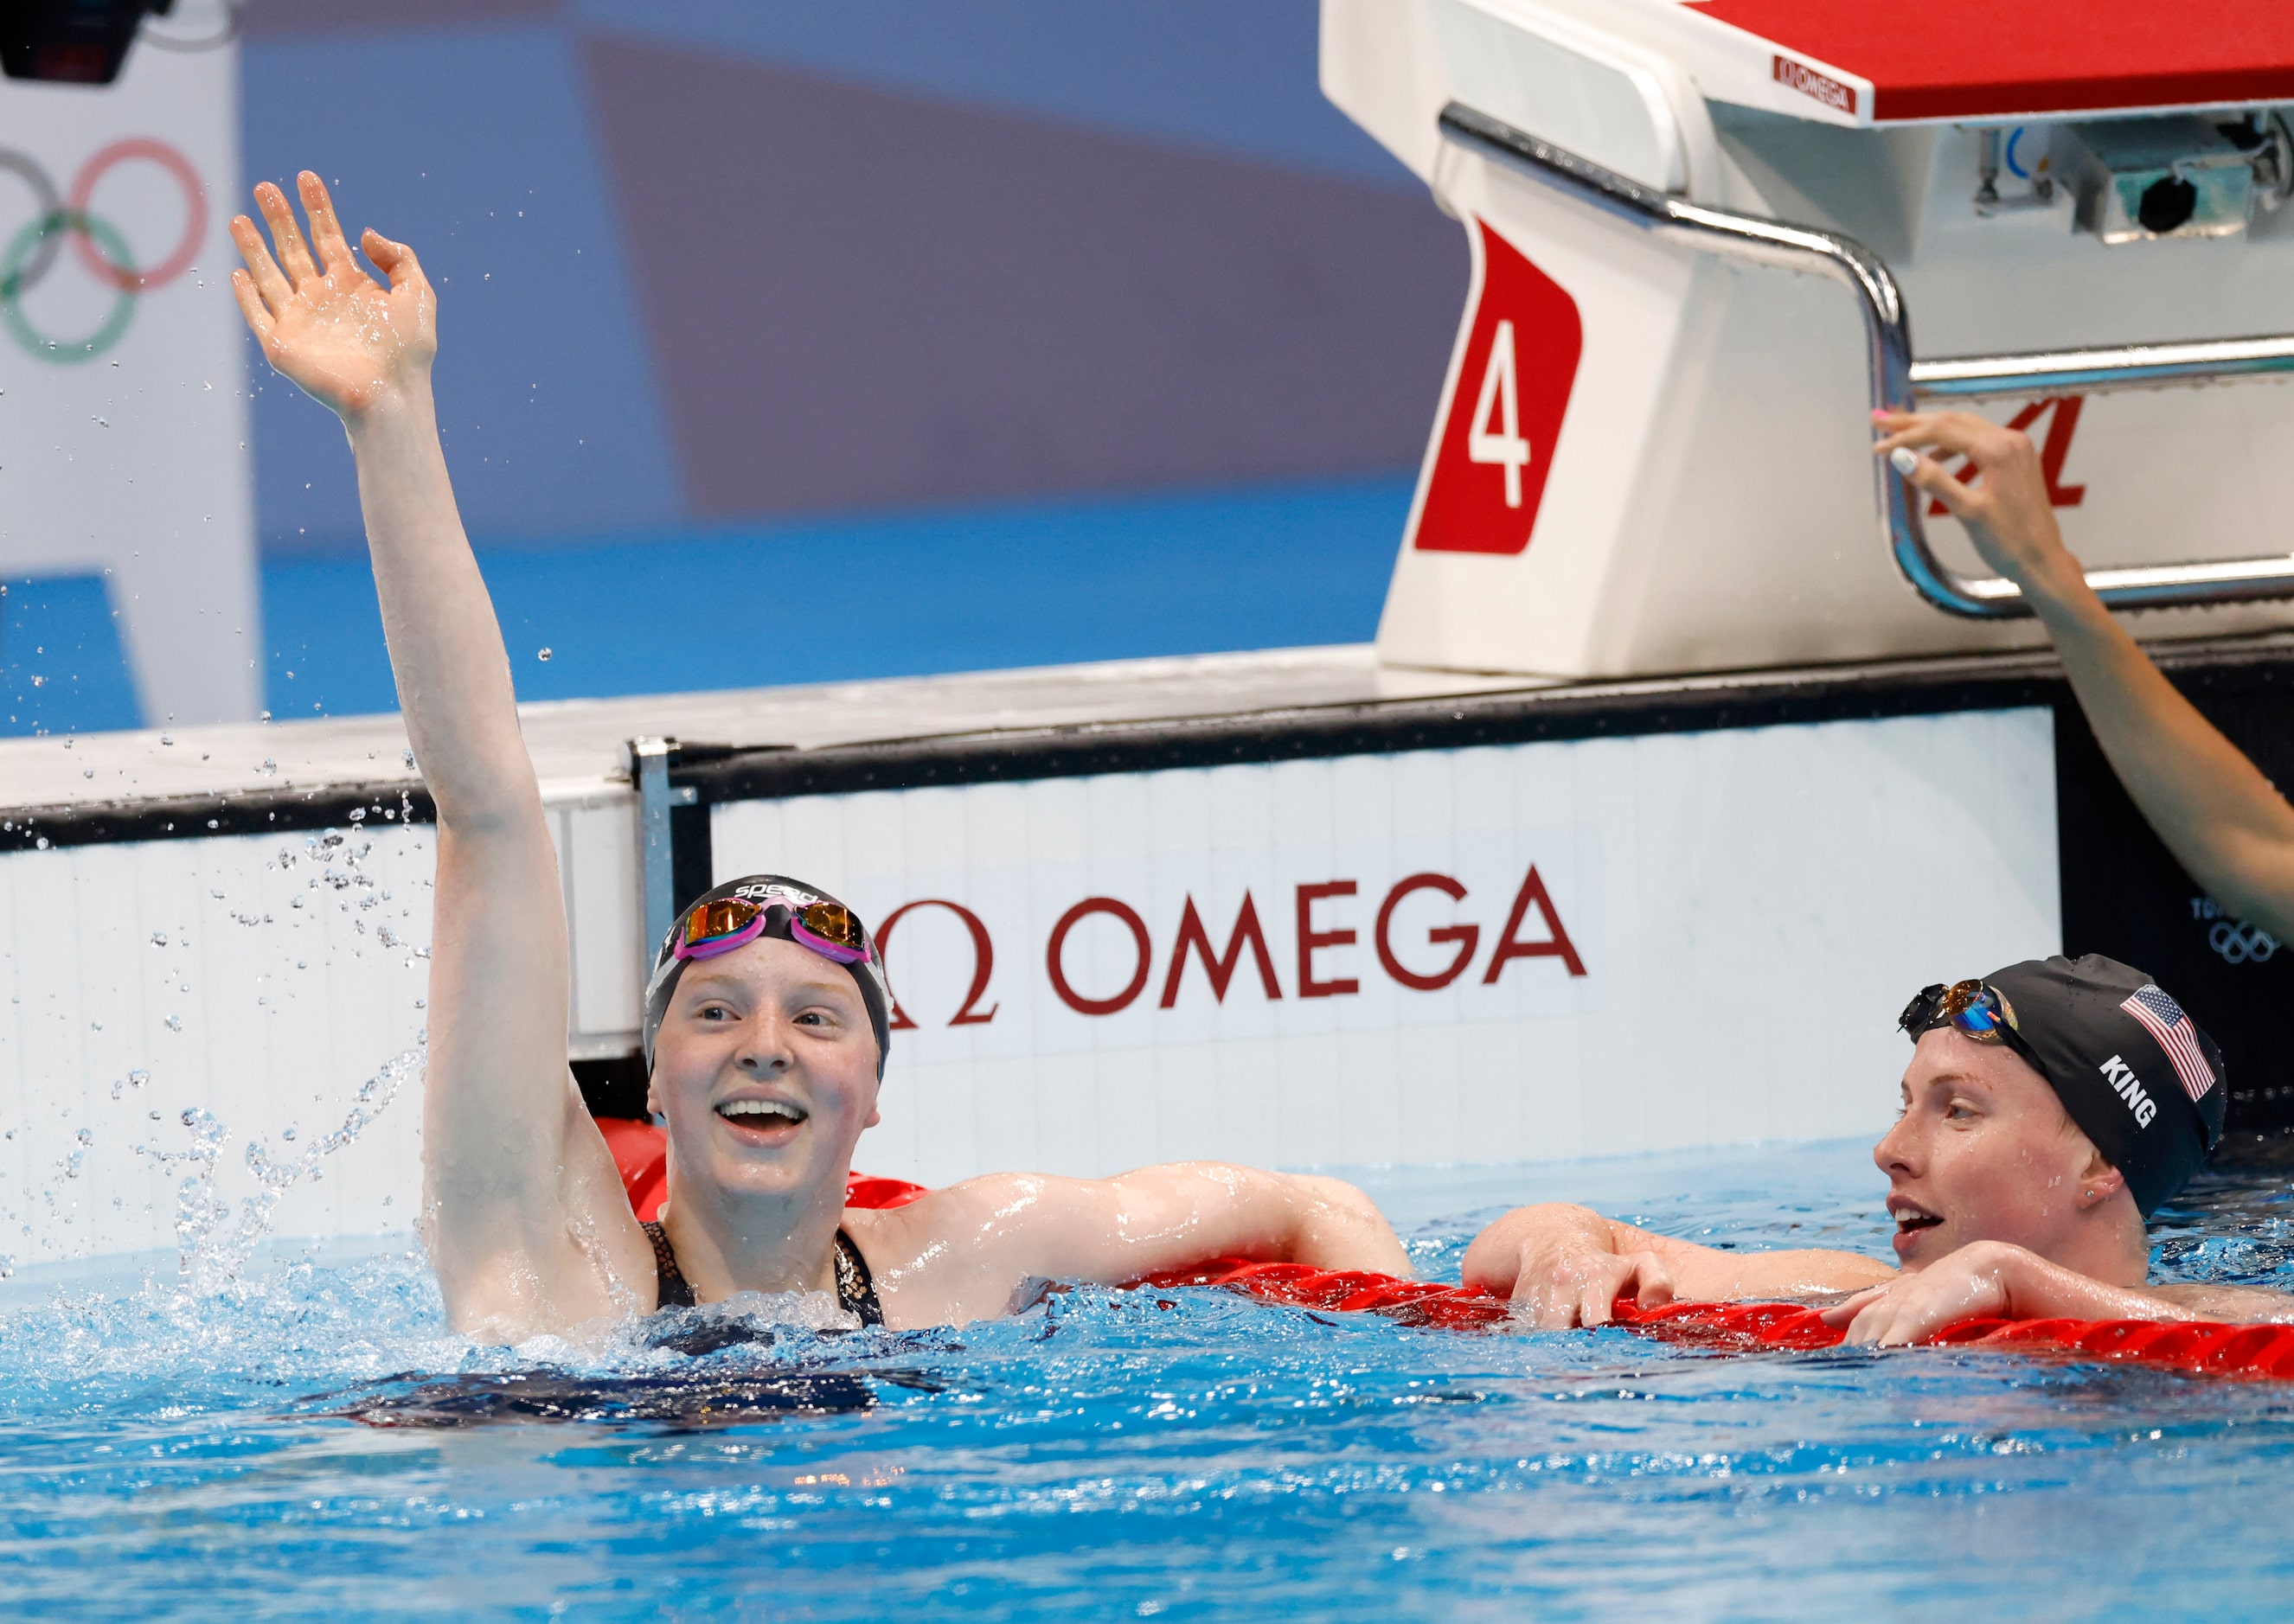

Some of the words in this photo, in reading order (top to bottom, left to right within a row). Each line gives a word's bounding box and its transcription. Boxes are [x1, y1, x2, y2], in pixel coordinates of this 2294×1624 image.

[1797, 67, 1849, 112] OMEGA
[1468, 320, 1531, 508] 4
[734, 884, 819, 906] speed
[1047, 864, 1587, 1016] OMEGA
[2099, 1054, 2157, 1129] KING
